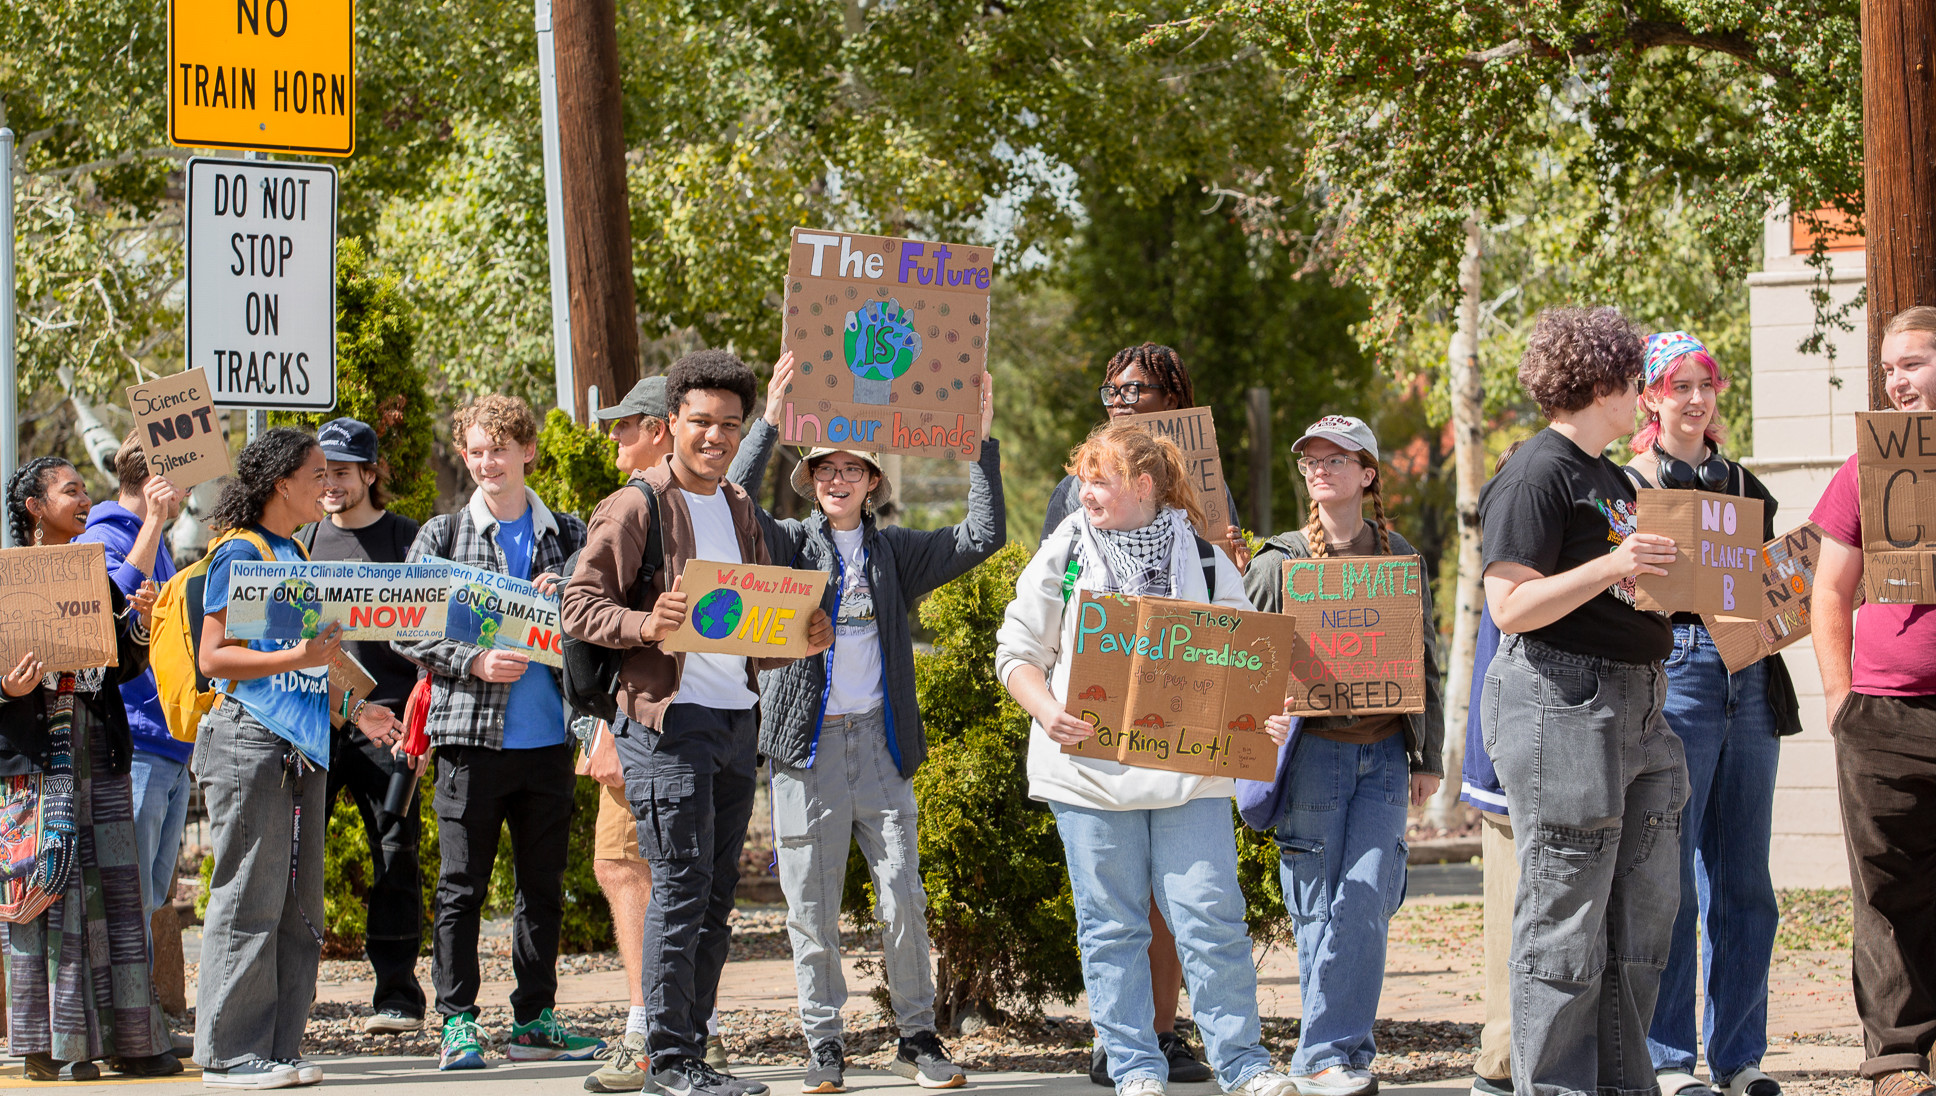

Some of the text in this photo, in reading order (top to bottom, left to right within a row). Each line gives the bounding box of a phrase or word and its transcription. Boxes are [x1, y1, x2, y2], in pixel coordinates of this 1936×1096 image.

[237, 0, 288, 37] NO
[180, 63, 346, 116] TRAIN HORN
[215, 174, 310, 221] DO NOT
[231, 233, 293, 278] STOP
[797, 233, 991, 289] The Future
[246, 292, 279, 336] ON
[214, 349, 310, 396] TRACKS
[133, 388, 201, 416] Science
[147, 405, 212, 448] NOT
[784, 402, 976, 454] In our hands
[1867, 416, 1936, 460] WE
[151, 451, 204, 476] Silence.
[1701, 499, 1737, 536] NO
[0, 549, 93, 587] RESPECT
[1701, 540, 1757, 572] PLANET
[1872, 554, 1898, 565] AND
[233, 564, 448, 582] Northern AZ Climate Change Alliance
[476, 572, 494, 586] AZ
[496, 577, 539, 598] Climate
[1286, 561, 1418, 602] CLIMATE
[232, 586, 447, 602] ACT ON CLIMATE CHANGE
[456, 588, 557, 627] ON CLIMATE
[1723, 573, 1736, 611] B
[56, 600, 101, 618] YOUR
[349, 605, 427, 628] NOW
[1190, 610, 1243, 634] They
[1321, 608, 1380, 628] NEED
[396, 630, 443, 638] NAZCCA.org
[1076, 602, 1264, 671] Paved Paradise
[1309, 631, 1386, 658] NOT
[271, 670, 329, 694] ADVOCA
[1135, 665, 1215, 695] to put up
[1291, 660, 1419, 682] CORPORATE
[1170, 696, 1182, 712] a
[1307, 681, 1402, 711] GREED
[1078, 709, 1233, 766] Parking Lot!
